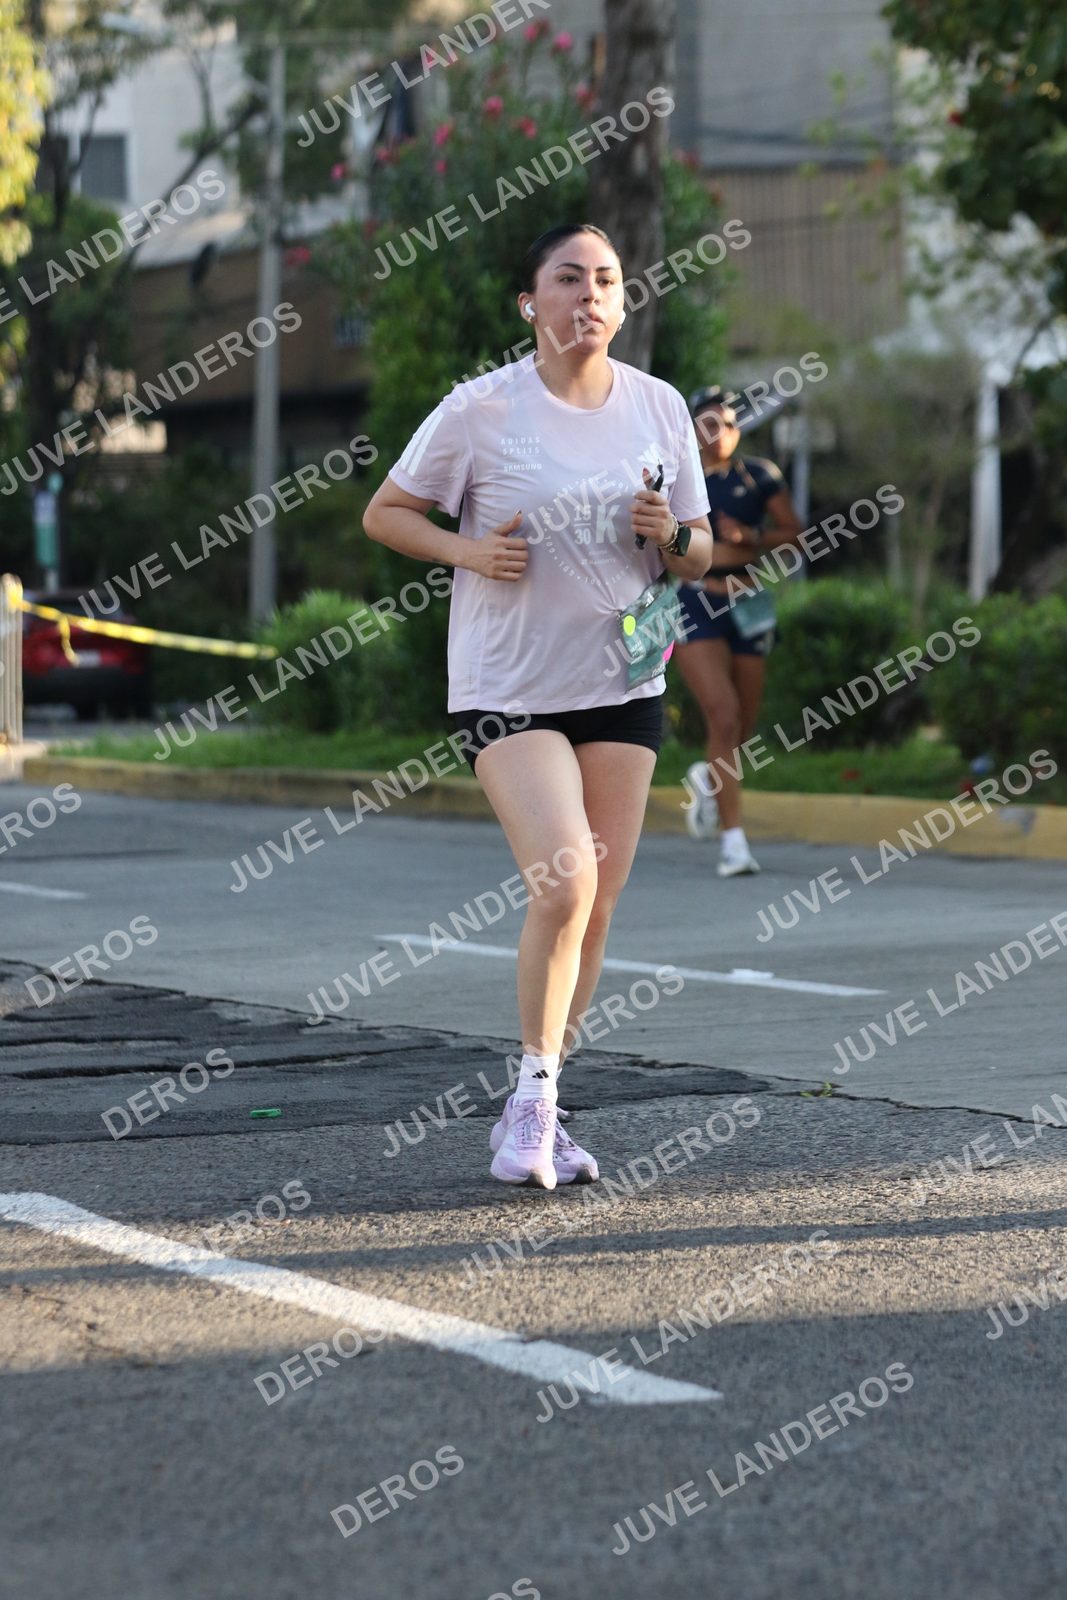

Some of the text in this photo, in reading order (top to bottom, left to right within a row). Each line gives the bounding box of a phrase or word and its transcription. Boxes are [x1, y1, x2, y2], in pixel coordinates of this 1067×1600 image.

[500, 436, 541, 445] ADIDAS
[502, 446, 541, 456] SPLITS
[503, 463, 542, 472] SAMSUNG
[574, 504, 620, 544] 15 K
[574, 528, 591, 545] 30
